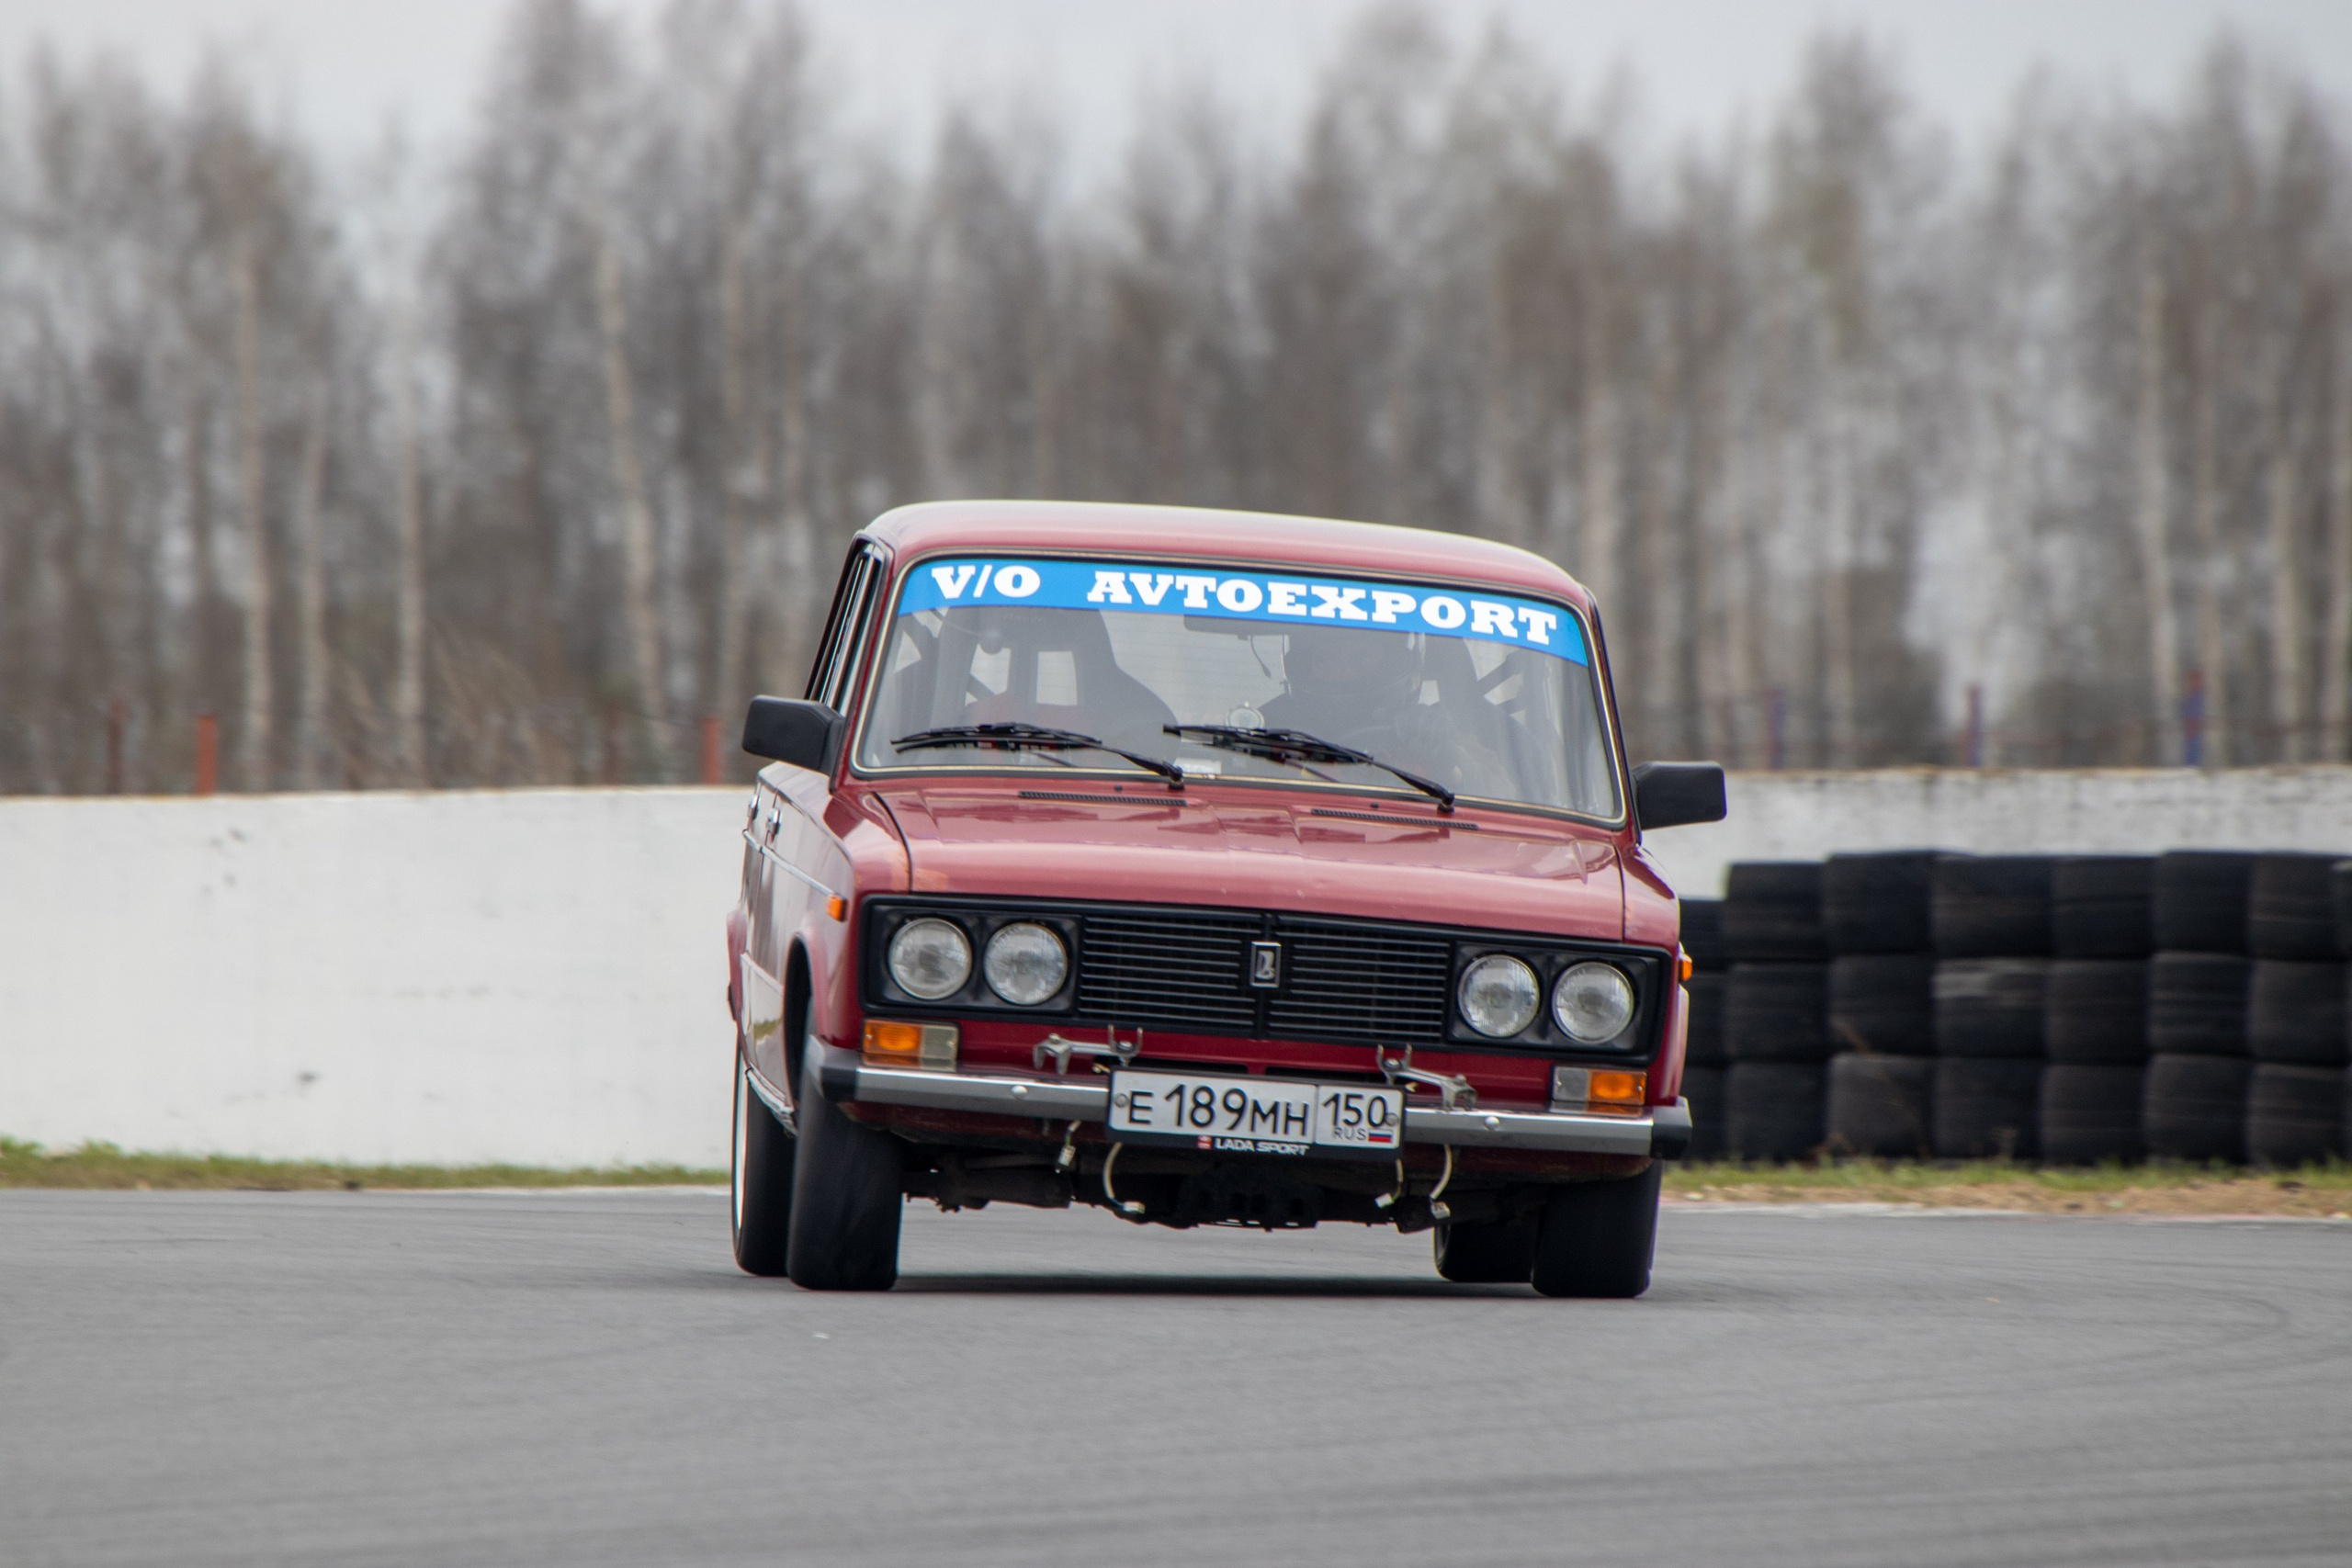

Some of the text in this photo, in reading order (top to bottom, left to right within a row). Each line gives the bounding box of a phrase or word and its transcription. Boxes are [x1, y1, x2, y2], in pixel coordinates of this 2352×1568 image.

[931, 565, 1556, 645] V/O AVTOEXPORT
[1322, 1092, 1389, 1128] 150
[1215, 1137, 1310, 1156] LADA SPORT
[1333, 1126, 1367, 1141] RUS
